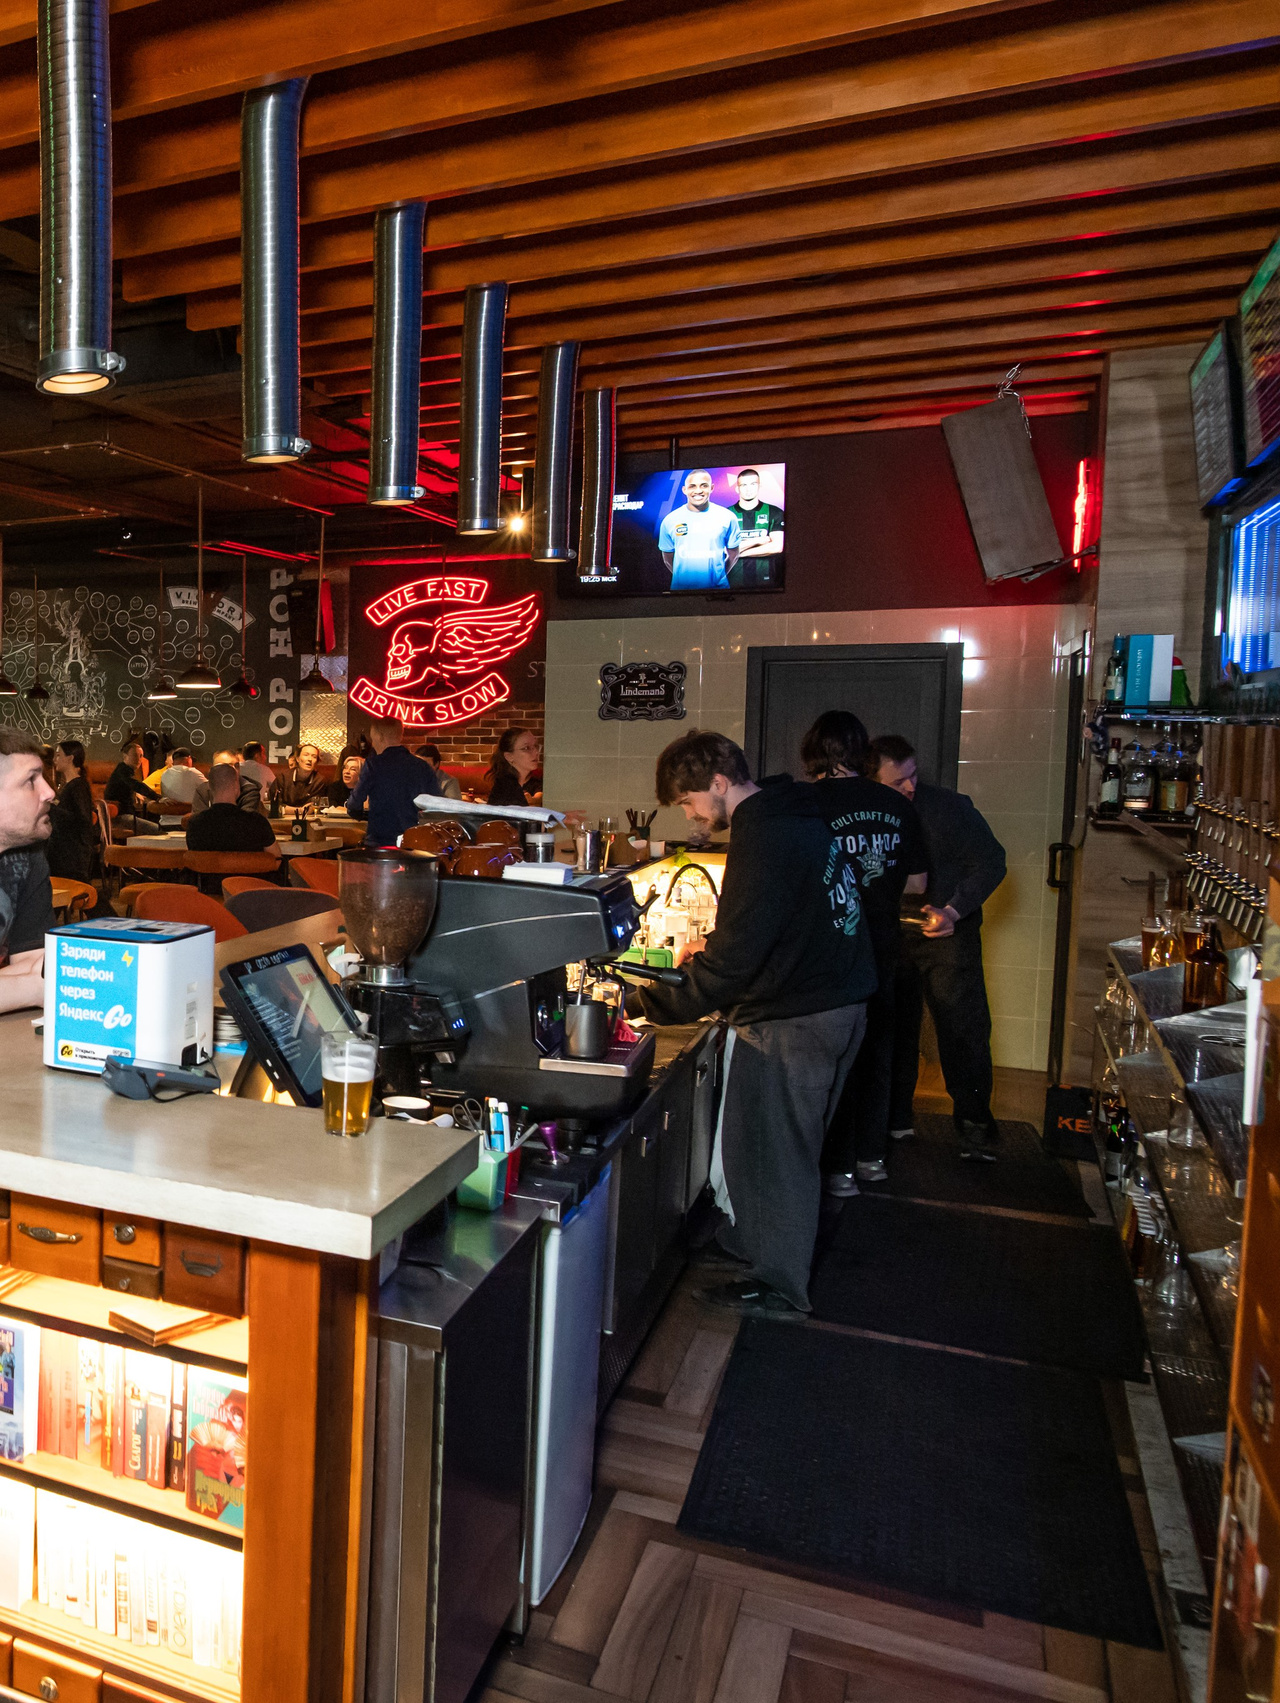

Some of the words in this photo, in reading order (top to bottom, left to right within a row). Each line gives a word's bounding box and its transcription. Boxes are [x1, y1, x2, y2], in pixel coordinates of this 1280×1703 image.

[374, 586, 418, 619] LIVE
[426, 581, 481, 598] FAST
[358, 686, 425, 722] DRINK
[434, 681, 497, 721] SLOW
[269, 677, 294, 764] TOP
[831, 814, 854, 831] CULT
[854, 811, 882, 821] CRAFT
[884, 813, 902, 828] BAR
[60, 941, 106, 962] Заряди
[60, 965, 114, 982] телефон
[60, 984, 96, 1001] через
[59, 1002, 104, 1023] Яндекс
[103, 1004, 133, 1030] Go
[61, 1045, 73, 1057] Go
[1057, 1116, 1092, 1134] KE
